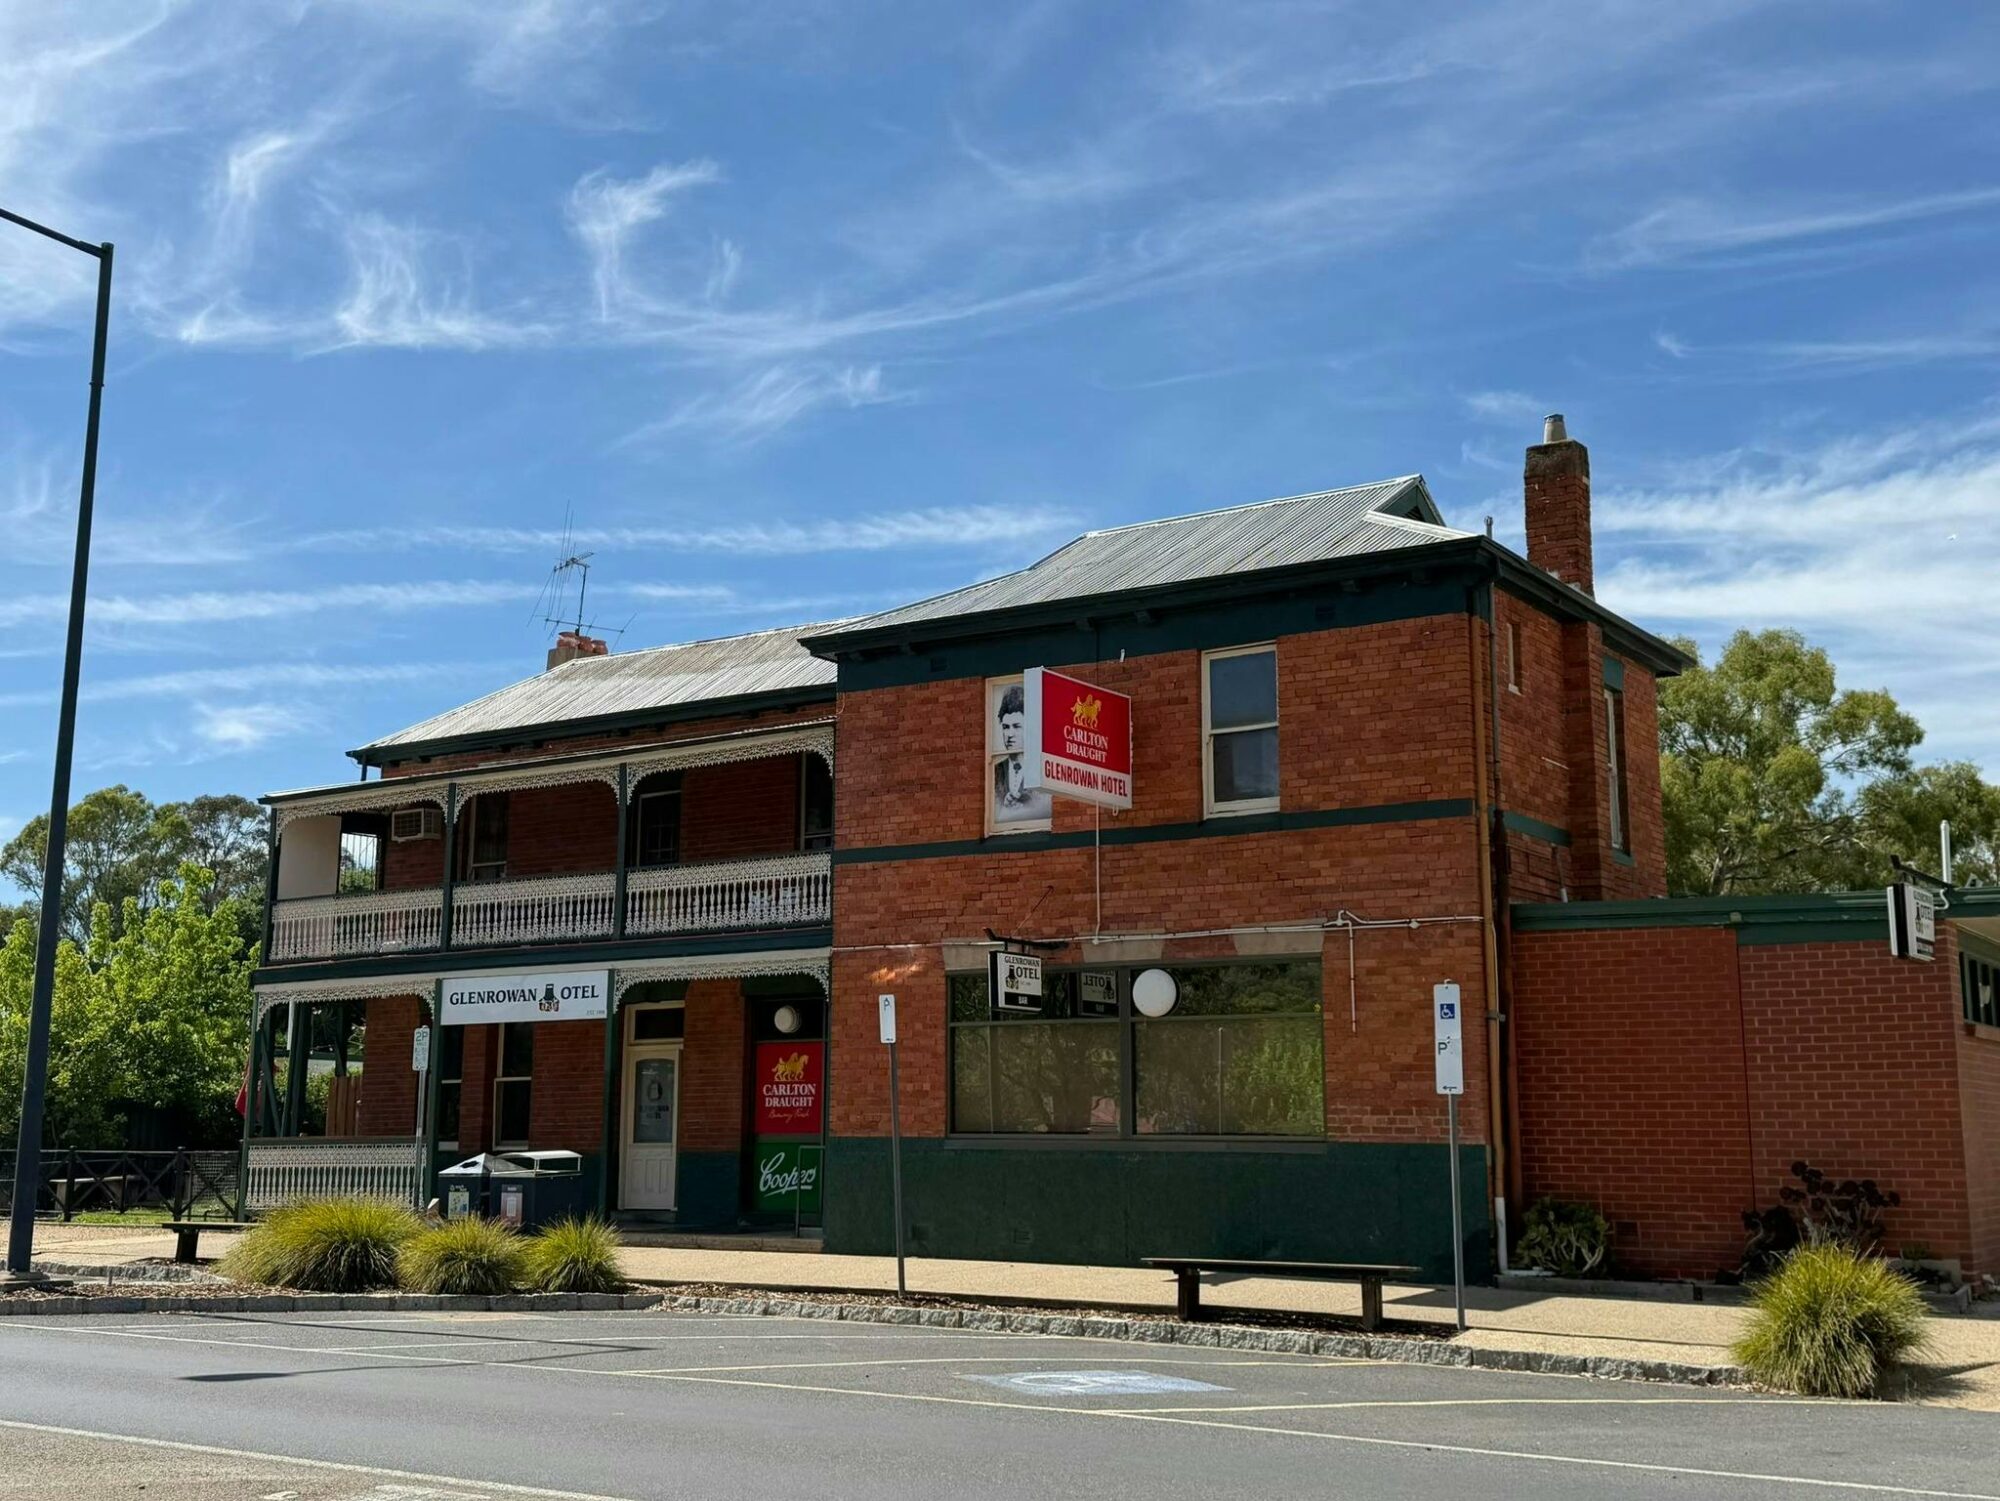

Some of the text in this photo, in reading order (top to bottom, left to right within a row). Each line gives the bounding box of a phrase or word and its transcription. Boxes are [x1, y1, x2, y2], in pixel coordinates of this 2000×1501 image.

[1063, 725, 1109, 750] CARLTON
[1066, 741, 1108, 763] DRAUGHT
[1044, 760, 1128, 797] GLENROWAN HOTEL
[1004, 955, 1040, 967] GLENROWAN
[1016, 966, 1040, 980] OTEL
[449, 984, 600, 1006] GLENROWAN OTEL
[415, 1031, 429, 1042] 2P
[1438, 1042, 1448, 1056] P
[763, 1083, 816, 1096] CARLTON
[765, 1097, 815, 1108] DRAUGHT
[759, 1152, 817, 1197] Coopers
